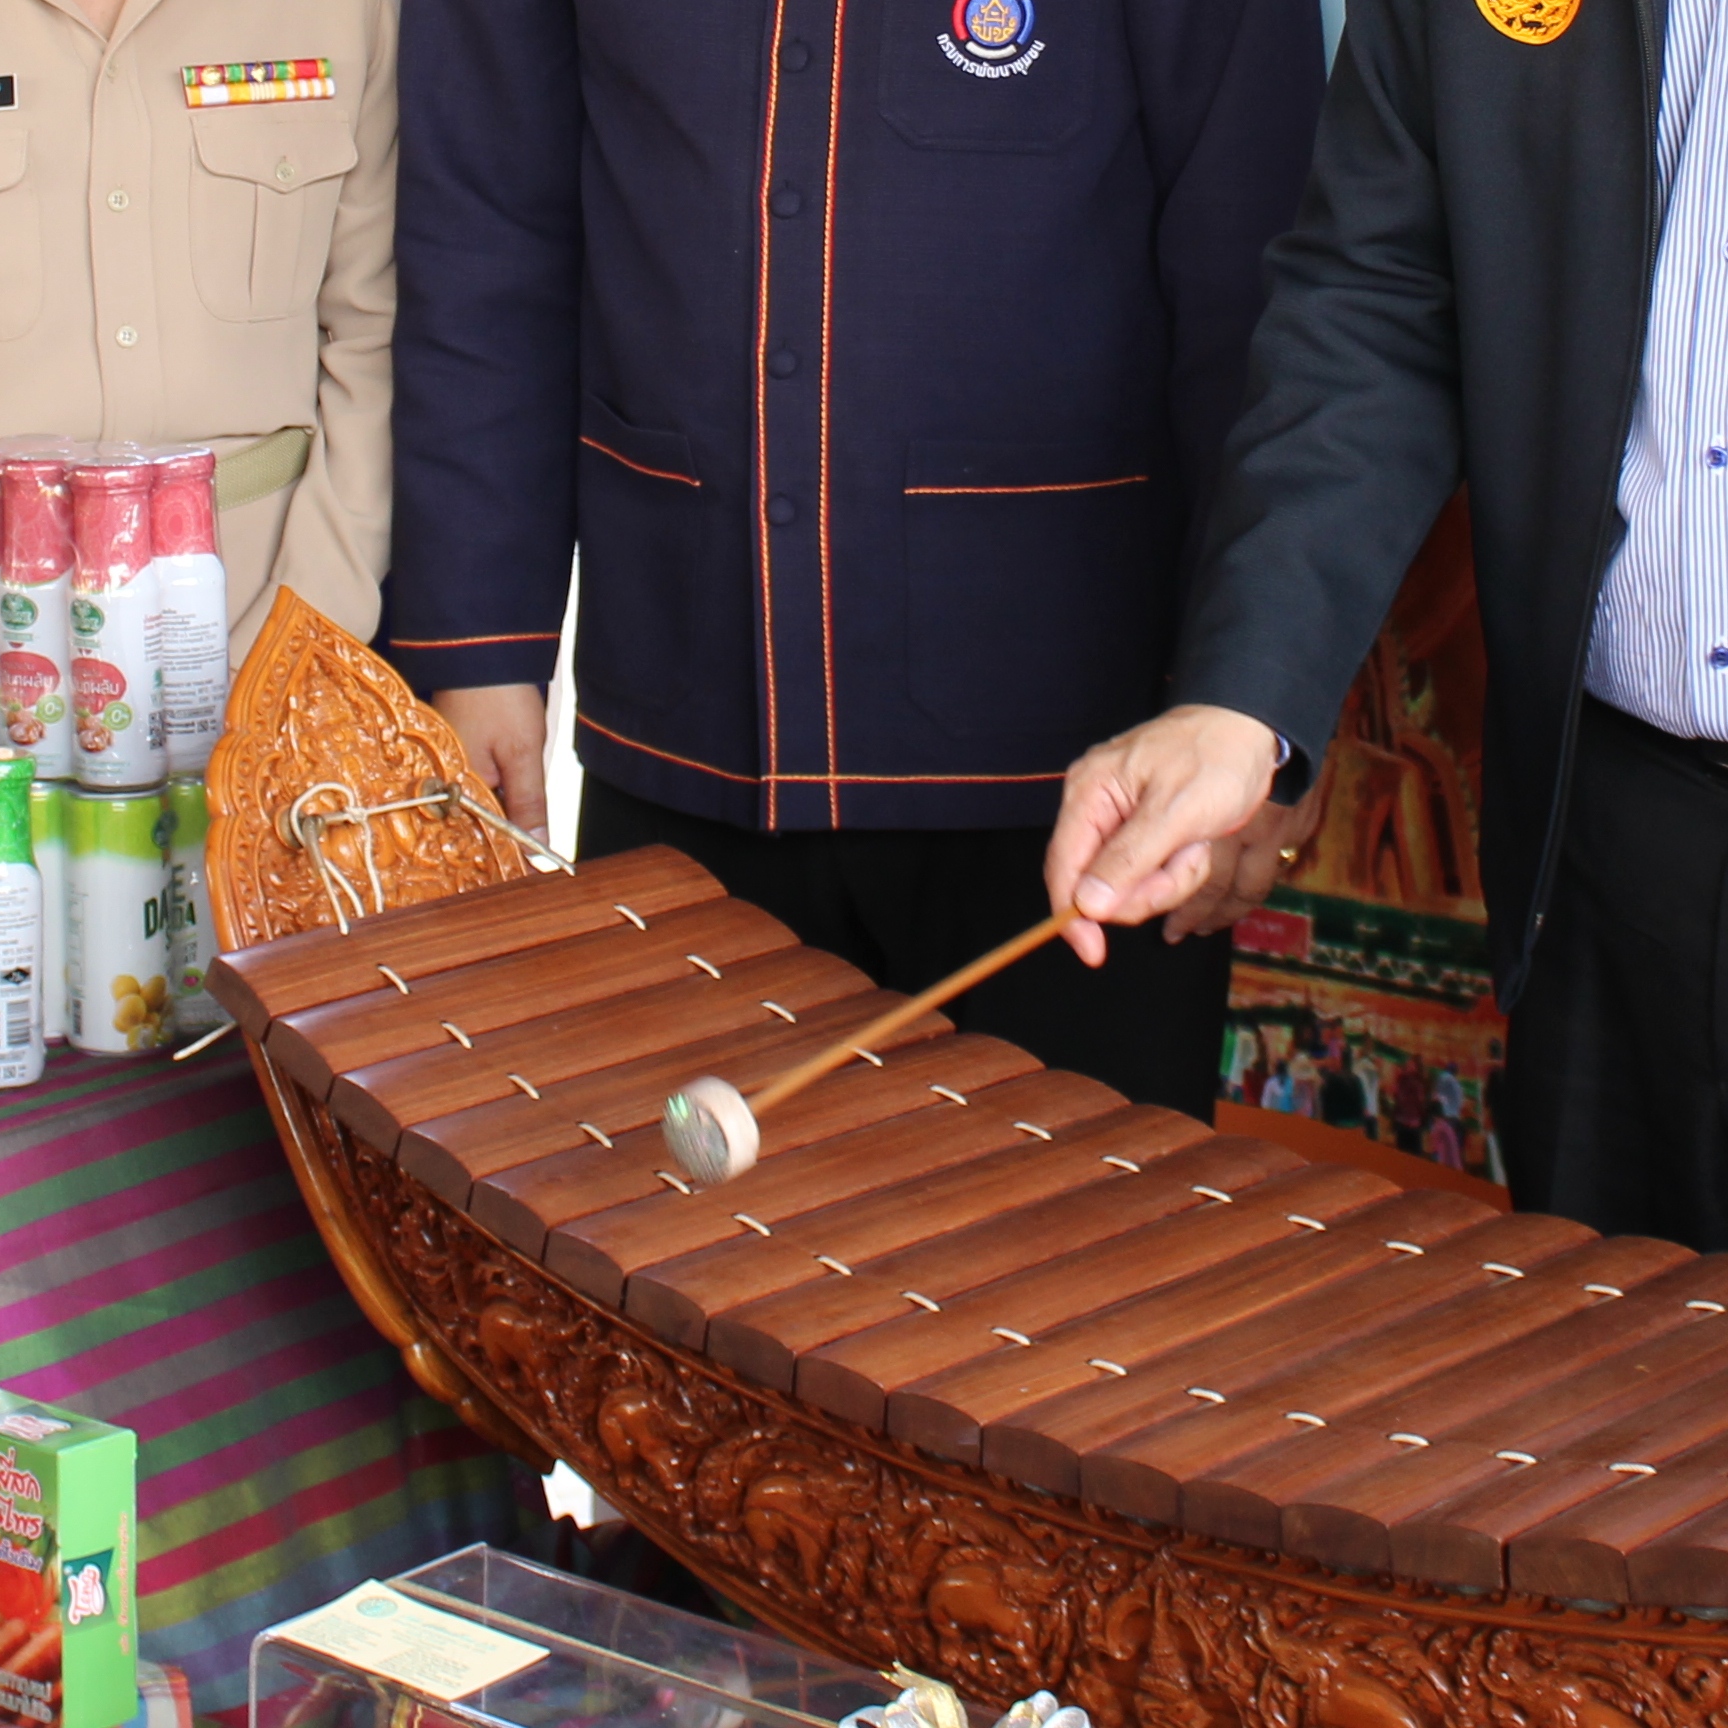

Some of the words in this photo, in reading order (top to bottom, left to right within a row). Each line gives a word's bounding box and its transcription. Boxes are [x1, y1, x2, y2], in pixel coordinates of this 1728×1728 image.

[936, 32, 1047, 80] กรมการพัฒนาชุมชน
